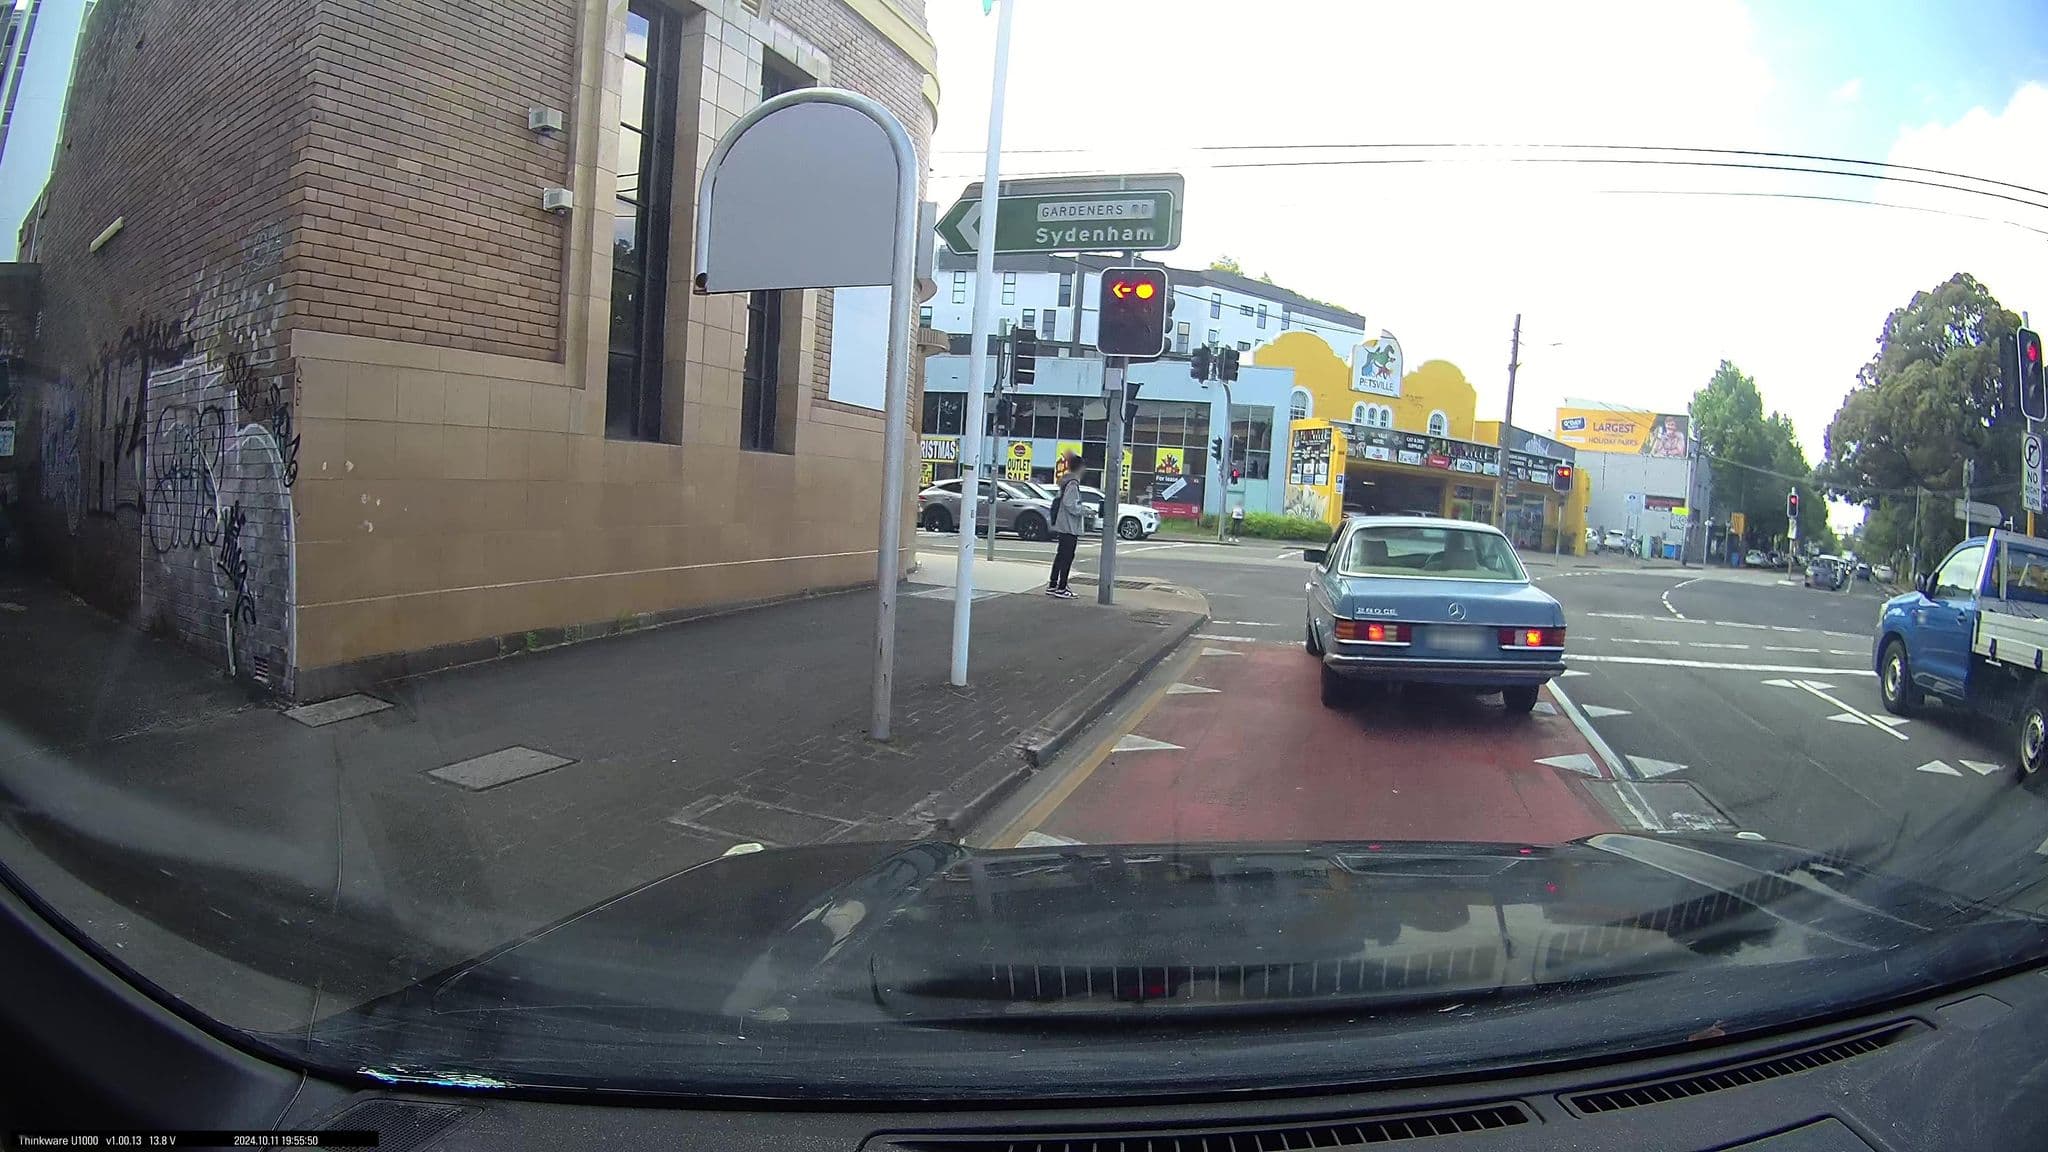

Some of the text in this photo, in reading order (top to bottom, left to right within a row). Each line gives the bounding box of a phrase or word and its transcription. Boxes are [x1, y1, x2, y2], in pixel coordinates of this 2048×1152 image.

[1041, 204, 1124, 218] GARDENERS
[1035, 225, 1155, 247] Sydenham
[1359, 377, 1394, 392] PETSVILLE
[1592, 422, 1636, 434] LARGEST
[1007, 458, 1030, 472] OUTLET
[2027, 471, 2038, 484] NO
[2026, 495, 2040, 507] TURN
